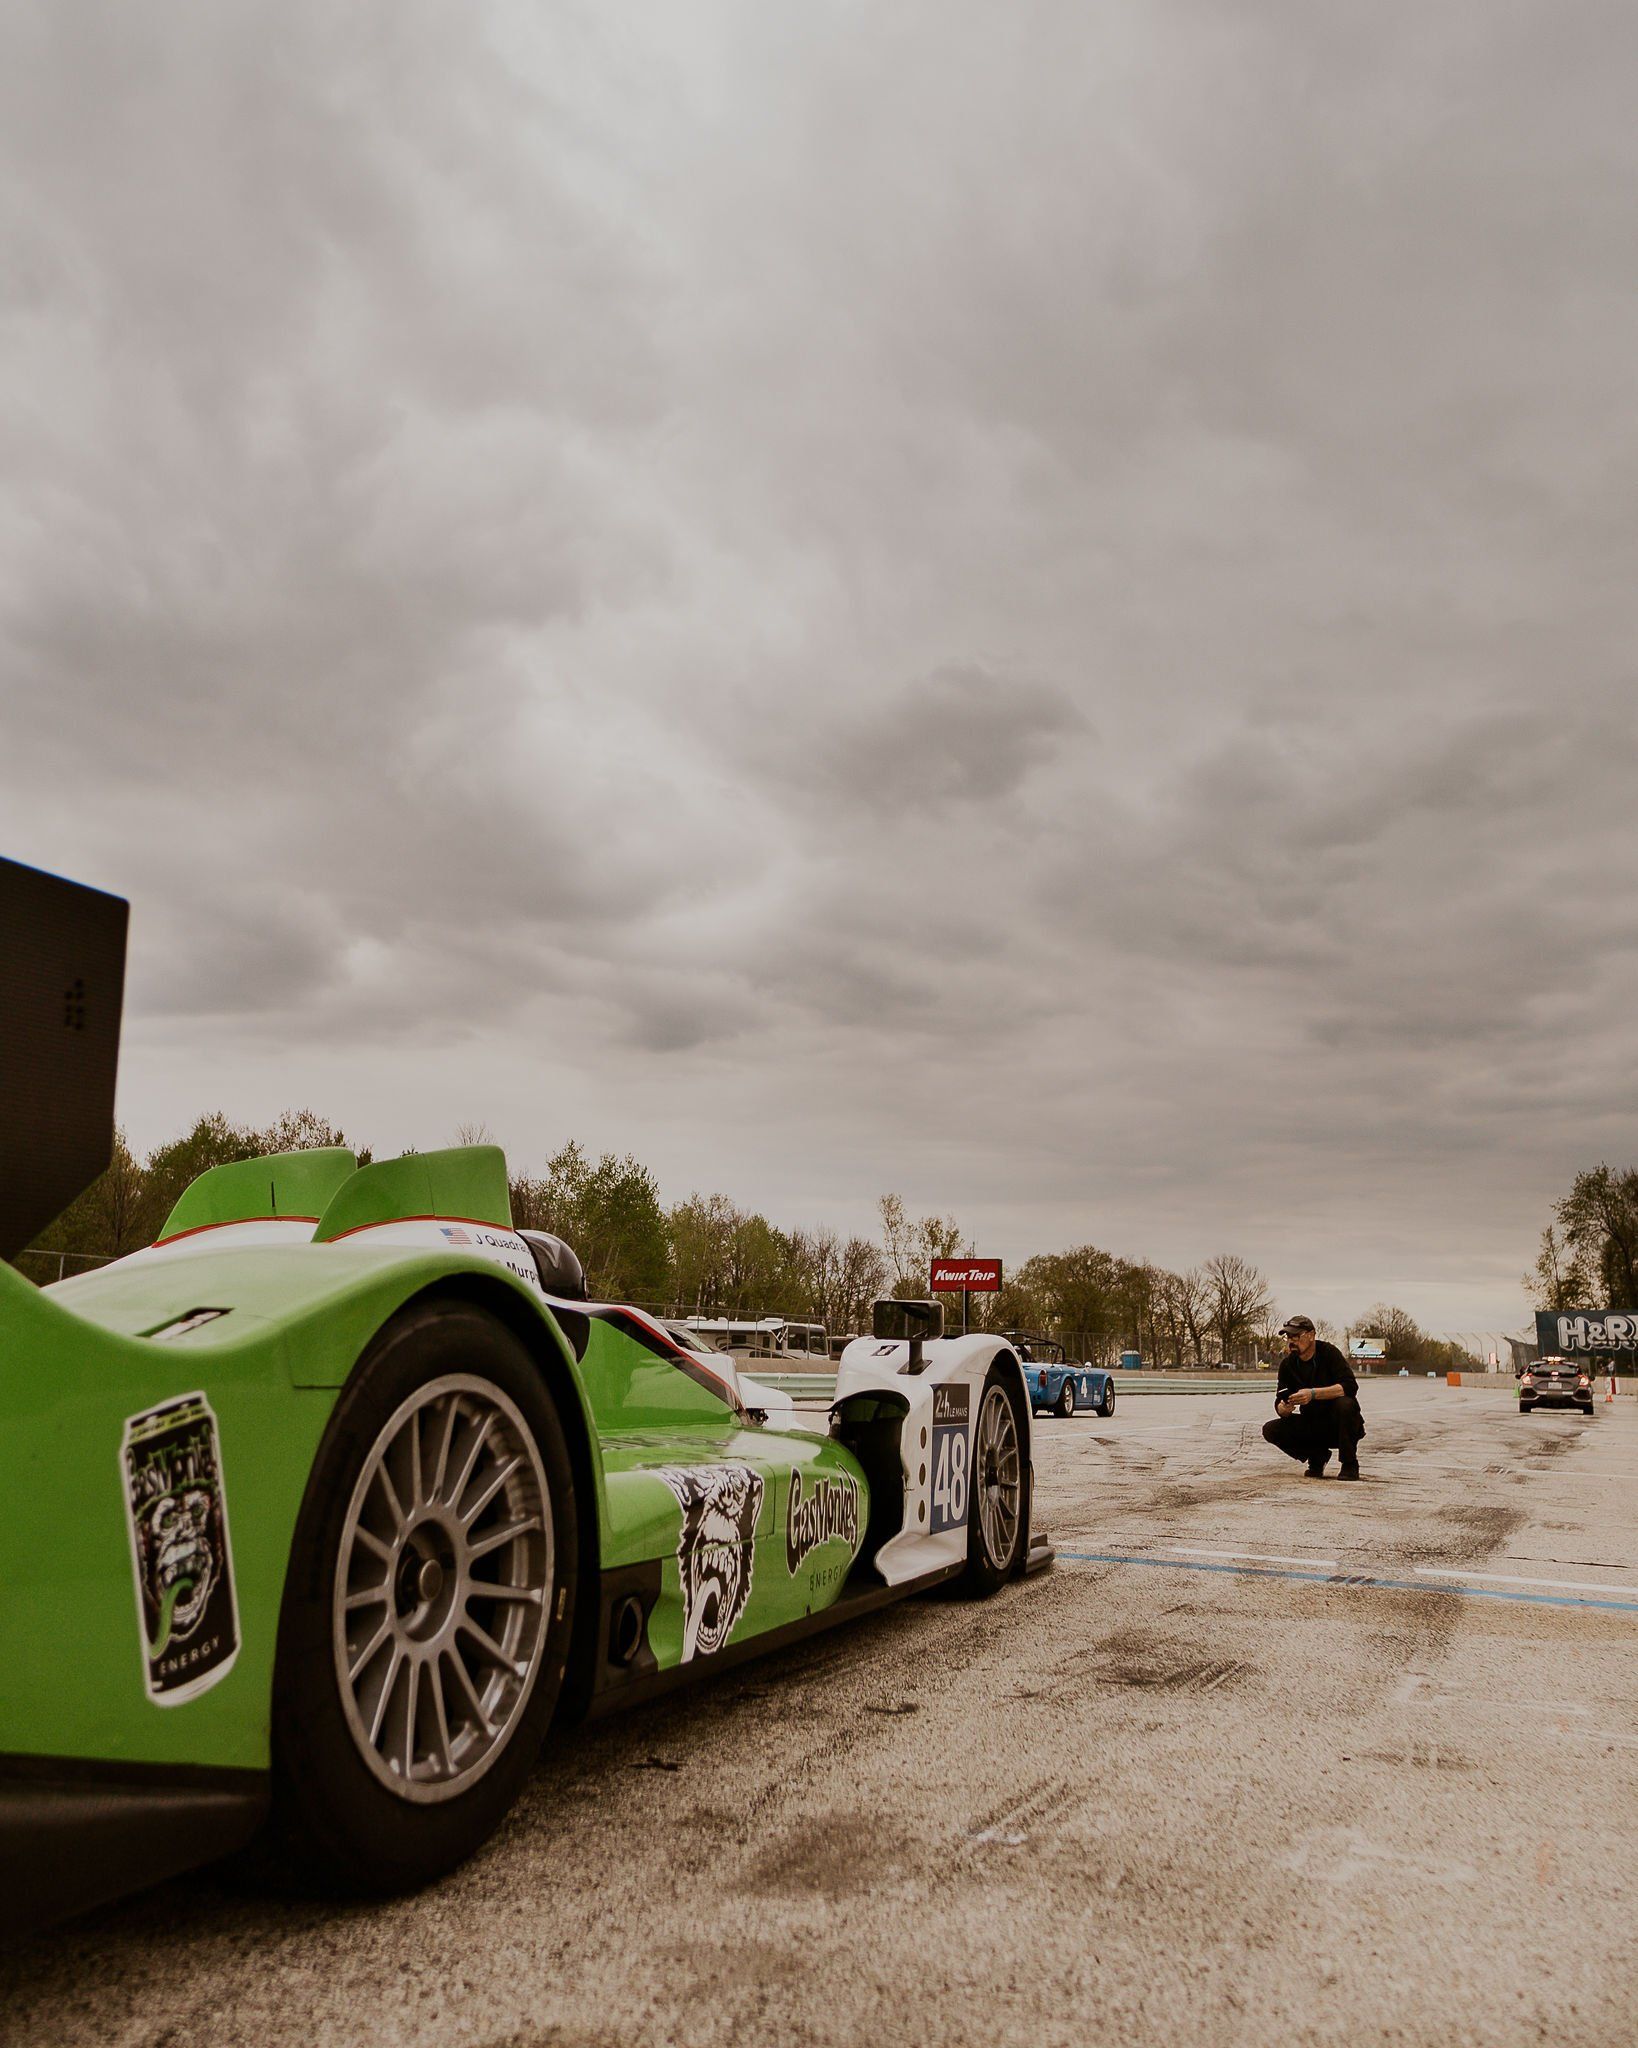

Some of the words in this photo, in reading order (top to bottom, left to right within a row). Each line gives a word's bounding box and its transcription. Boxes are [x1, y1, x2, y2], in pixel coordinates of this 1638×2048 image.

[476, 1233, 483, 1245] J
[1557, 1315, 1635, 1351] H&R
[1080, 1376, 1088, 1398] 4
[934, 1432, 966, 1523] 48
[810, 1564, 844, 1591] ENERGY
[160, 1635, 219, 1675] ENERGY
